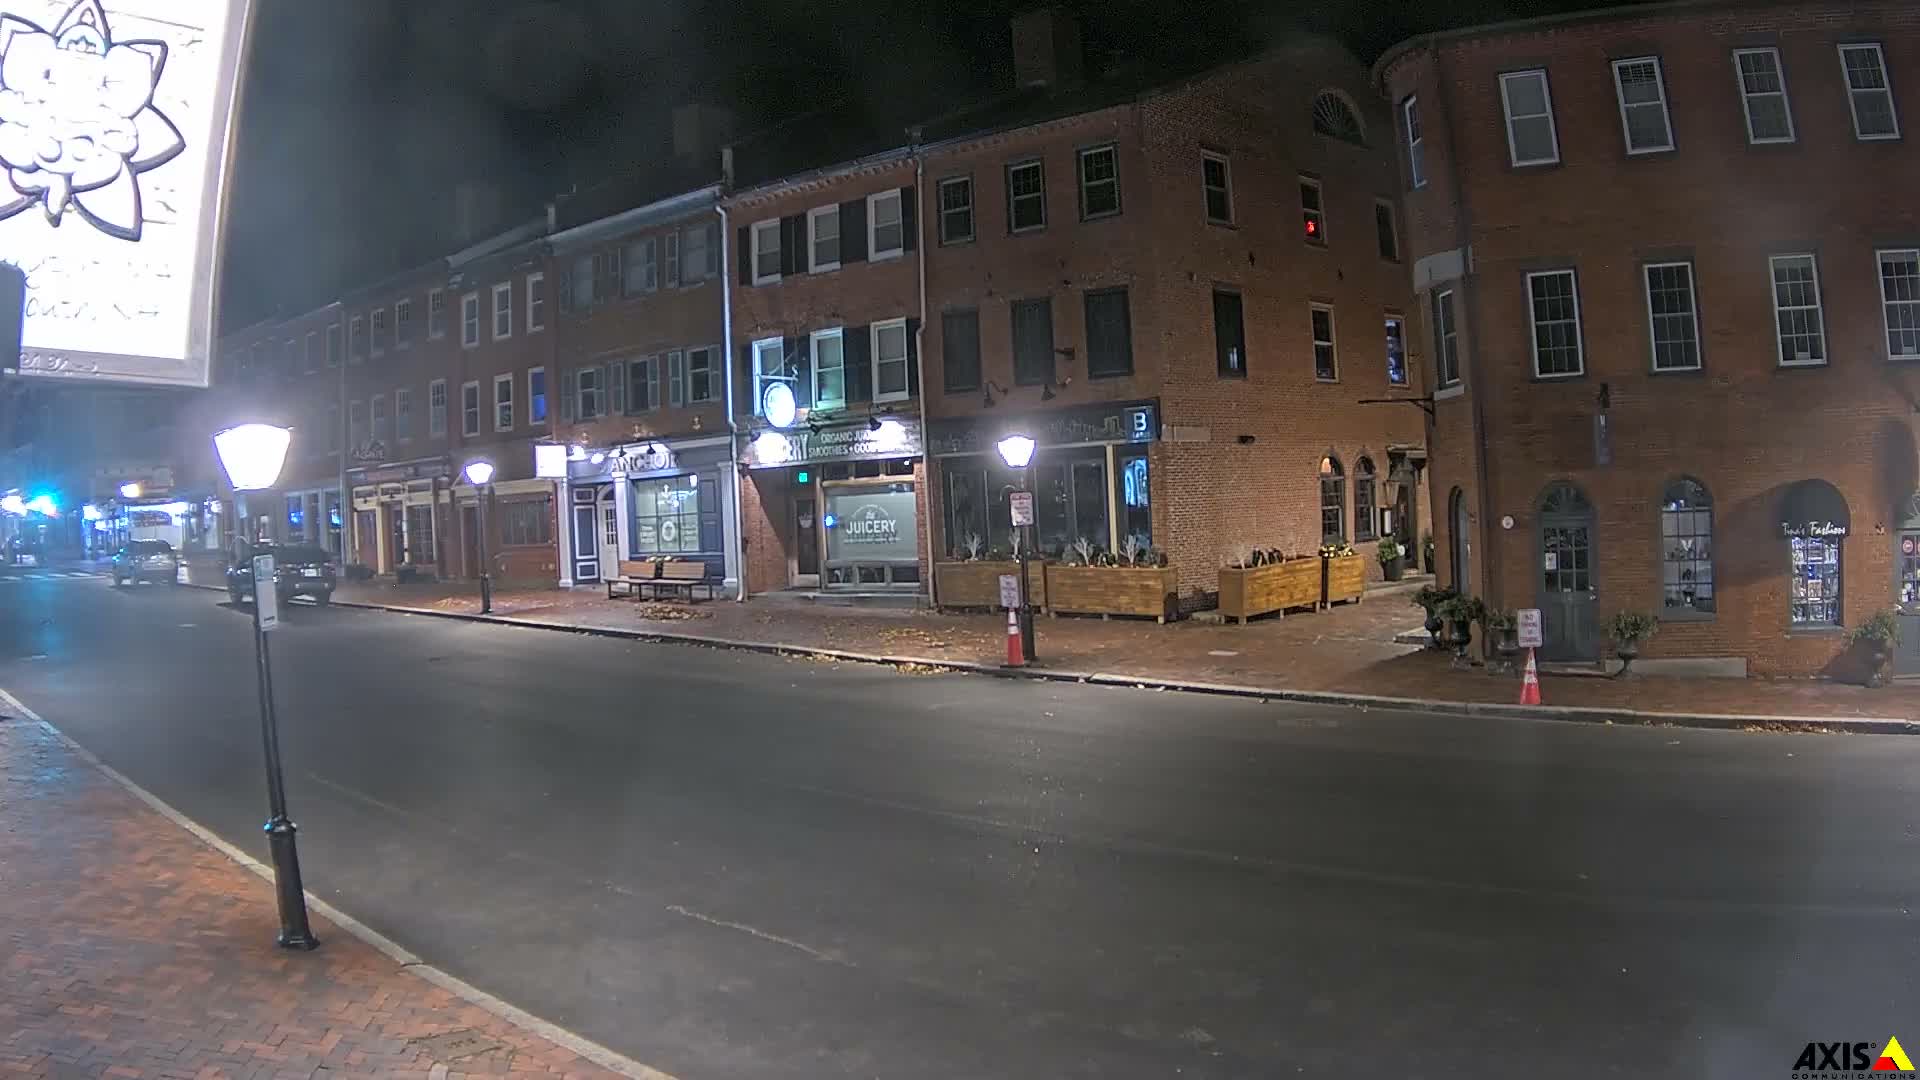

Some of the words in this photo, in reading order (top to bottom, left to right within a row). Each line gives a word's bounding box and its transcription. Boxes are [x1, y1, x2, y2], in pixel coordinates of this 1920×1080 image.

[1133, 412, 1147, 431] B
[820, 431, 853, 444] ORGANIC
[808, 444, 849, 458] SMOOTHIES
[846, 519, 897, 534] JUICERY
